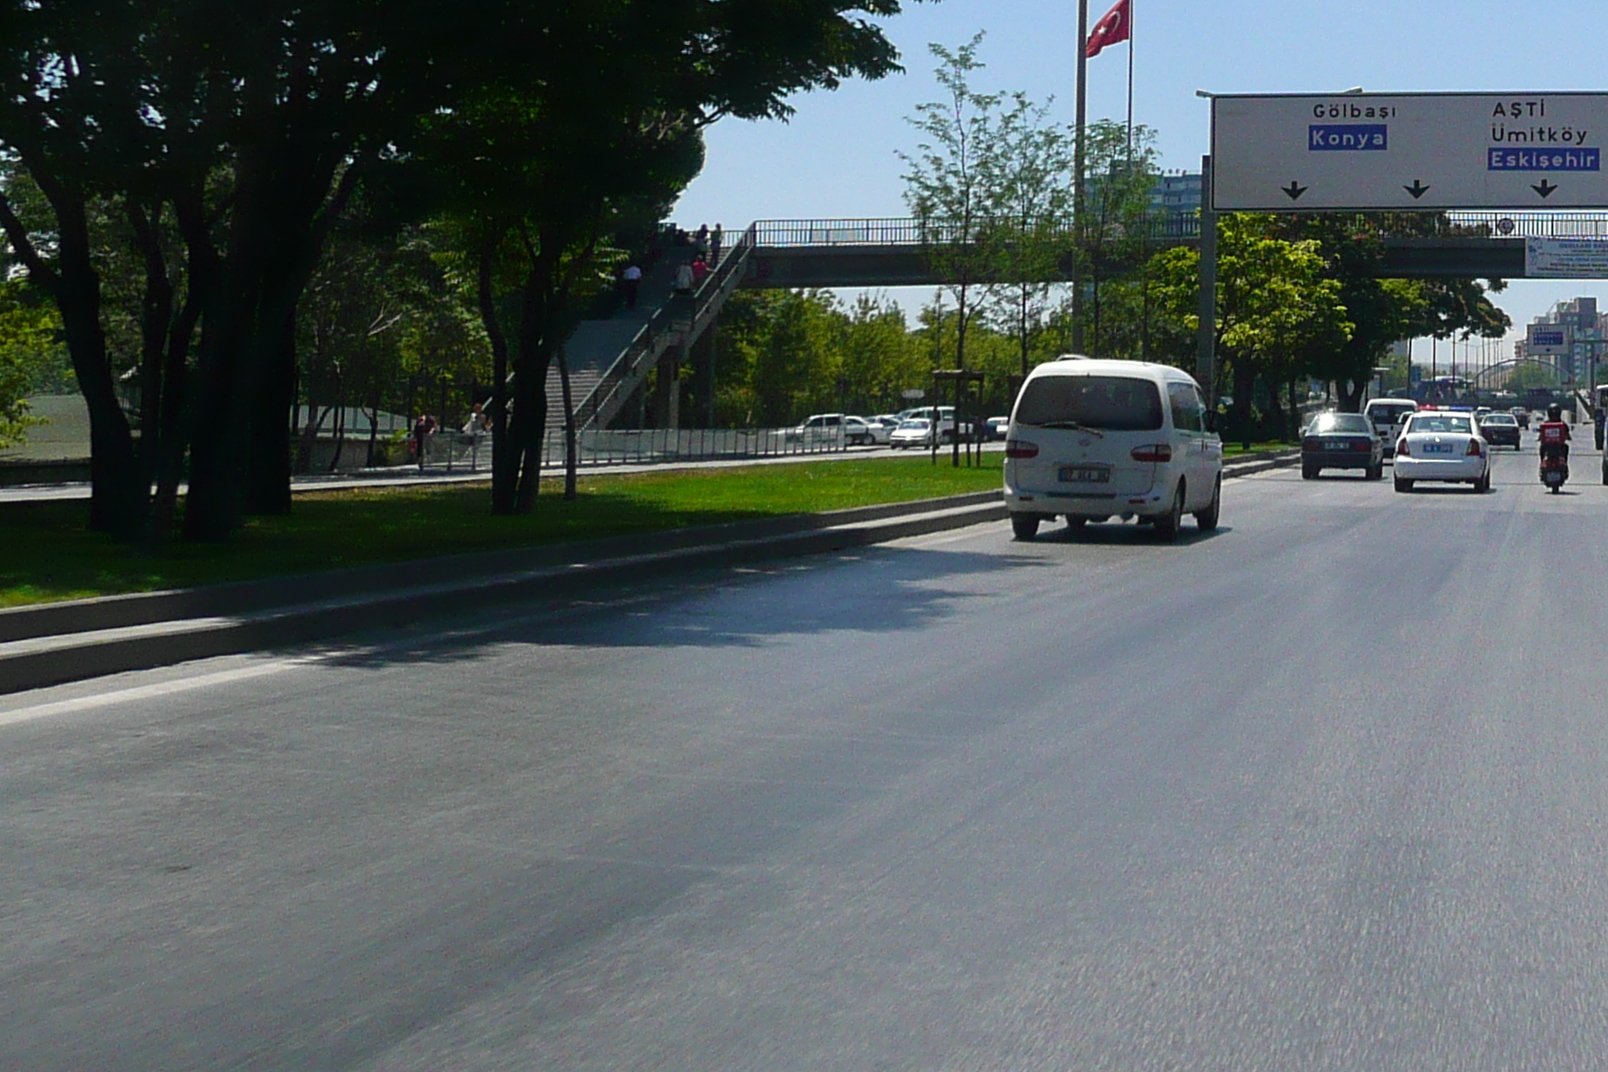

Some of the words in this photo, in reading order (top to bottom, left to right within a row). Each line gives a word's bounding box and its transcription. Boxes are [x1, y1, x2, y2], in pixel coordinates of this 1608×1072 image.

[1312, 102, 1396, 120] Gölbaşı
[1491, 98, 1545, 119] AŞTİ
[1312, 130, 1384, 149] Konya
[1491, 123, 1587, 145] Ümitköy
[1491, 151, 1595, 169] Eskişehir
